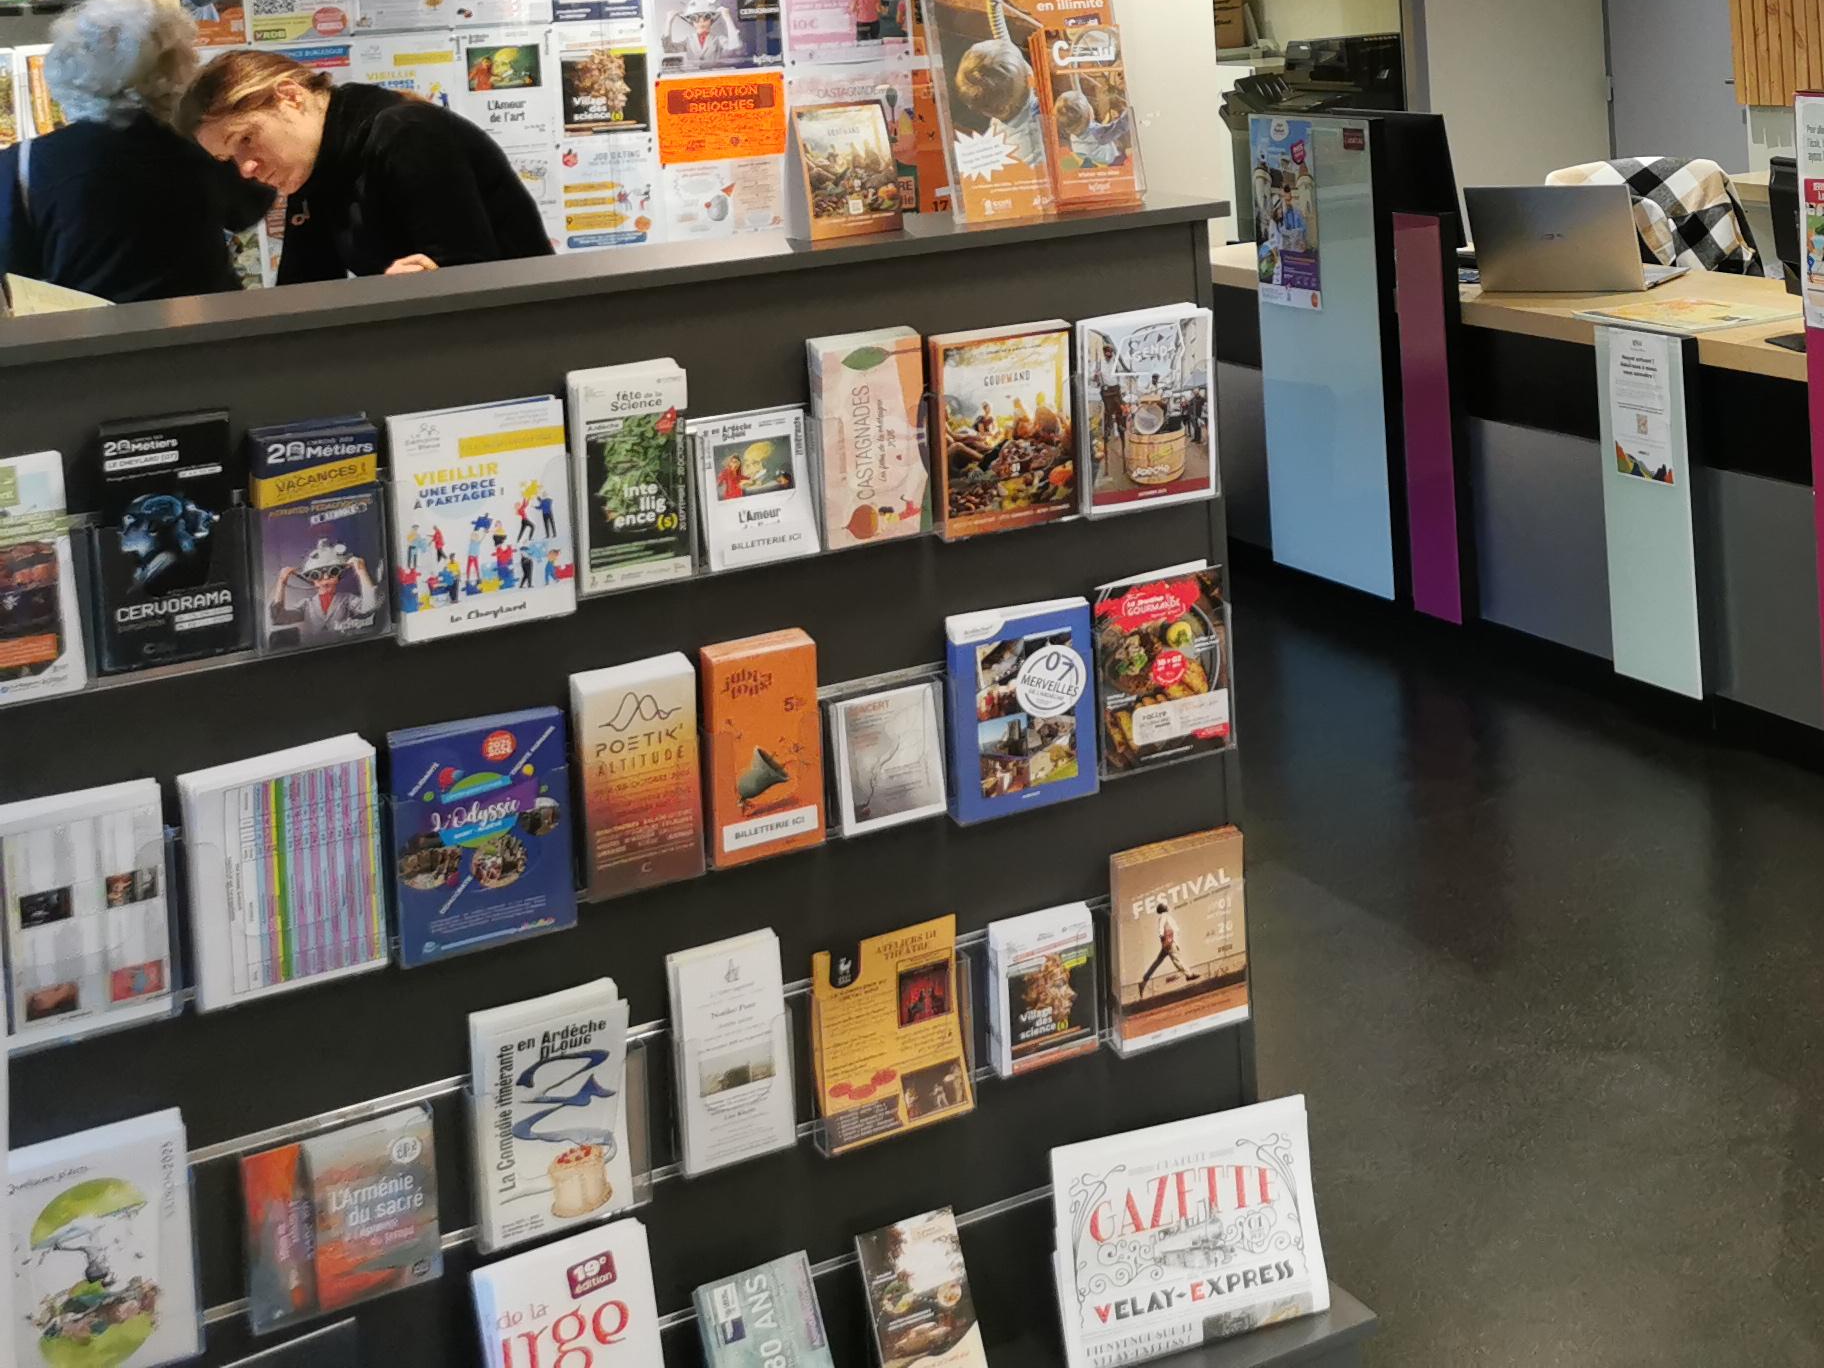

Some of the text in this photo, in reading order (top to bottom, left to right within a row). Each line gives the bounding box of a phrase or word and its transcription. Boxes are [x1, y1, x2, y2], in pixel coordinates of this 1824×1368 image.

[1036, 2, 1054, 11] en
[487, 99, 526, 111] L'Amour
[689, 99, 755, 113] BRIOCHES
[490, 111, 526, 123] de l'art
[984, 369, 1031, 387] GOURMAND
[610, 397, 662, 412] Science
[616, 390, 642, 402] fête
[131, 437, 178, 453] Métiers
[306, 442, 374, 459] Métiers
[851, 384, 875, 500] CASTAGNADES
[275, 464, 357, 493] VACANCES
[413, 462, 498, 487] VIEILLIR
[418, 478, 497, 499] UNE FORCE
[425, 489, 496, 509] PARTAGER
[623, 483, 658, 498] inte
[639, 496, 667, 513] llig
[738, 507, 781, 524] L'Amour
[731, 533, 802, 551] BILLETTERIE ICI
[116, 589, 232, 623] CERVORAMA
[466, 601, 527, 621] Cheylard
[1045, 651, 1075, 682] 07
[1020, 674, 1080, 697] MERVEILLES
[598, 744, 685, 777] ALTITUDE
[734, 816, 805, 840] BILLETTERIE ICI
[1132, 867, 1232, 921] FESTIVAL
[1019, 1006, 1053, 1022] Village
[517, 1018, 607, 1052] en Ardèche
[495, 1043, 516, 1194] La Comédie itinérante
[329, 1173, 413, 1212] L'Arménie
[349, 1186, 424, 1227] du sacré
[1089, 1164, 1280, 1246] GAZETTE
[574, 1271, 612, 1293] édition
[1094, 1258, 1295, 1324] VELAY-EXPRESS
[530, 1303, 549, 1320] la
[744, 1273, 778, 1330] ANS
